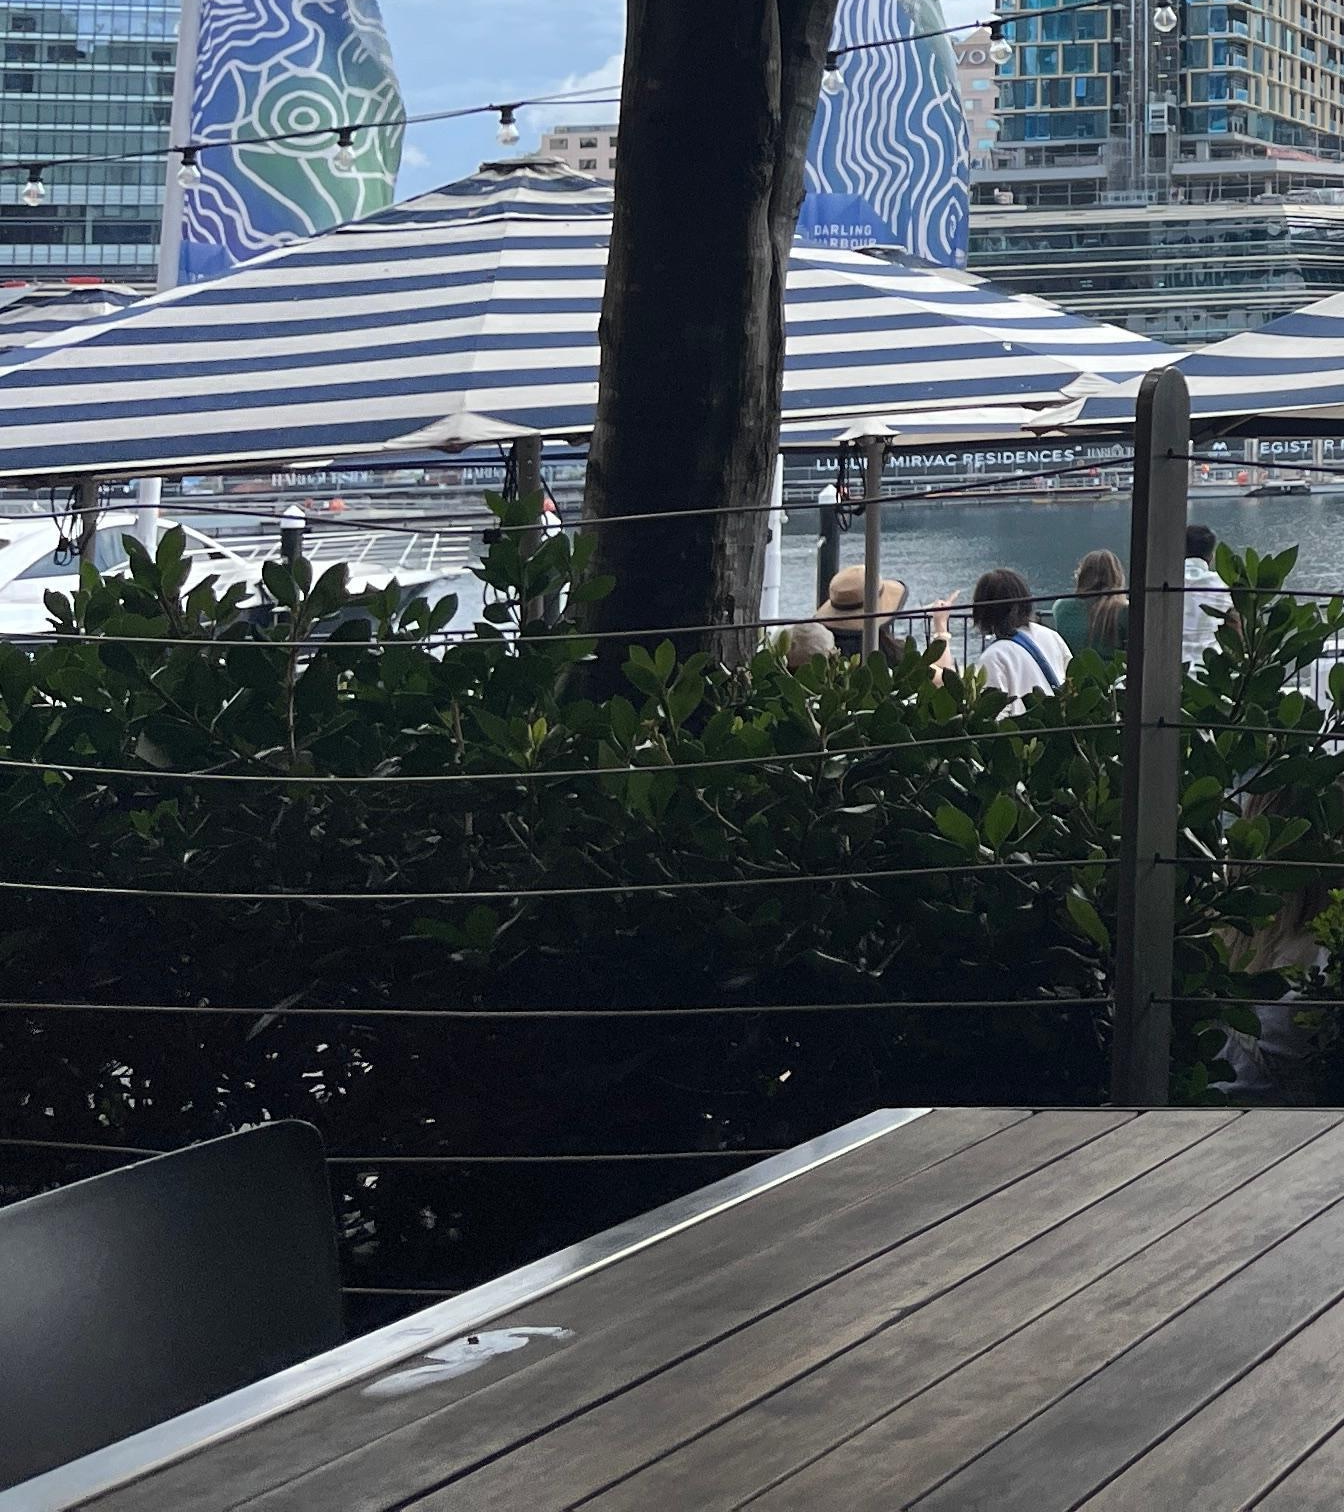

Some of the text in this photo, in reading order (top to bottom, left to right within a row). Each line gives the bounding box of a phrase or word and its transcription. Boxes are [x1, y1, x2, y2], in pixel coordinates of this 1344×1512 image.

[813, 223, 872, 236] DARLING
[1260, 439, 1334, 455] EGISTR
[890, 453, 957, 468] MIRVAC
[962, 449, 1075, 467] RESIDENCES
